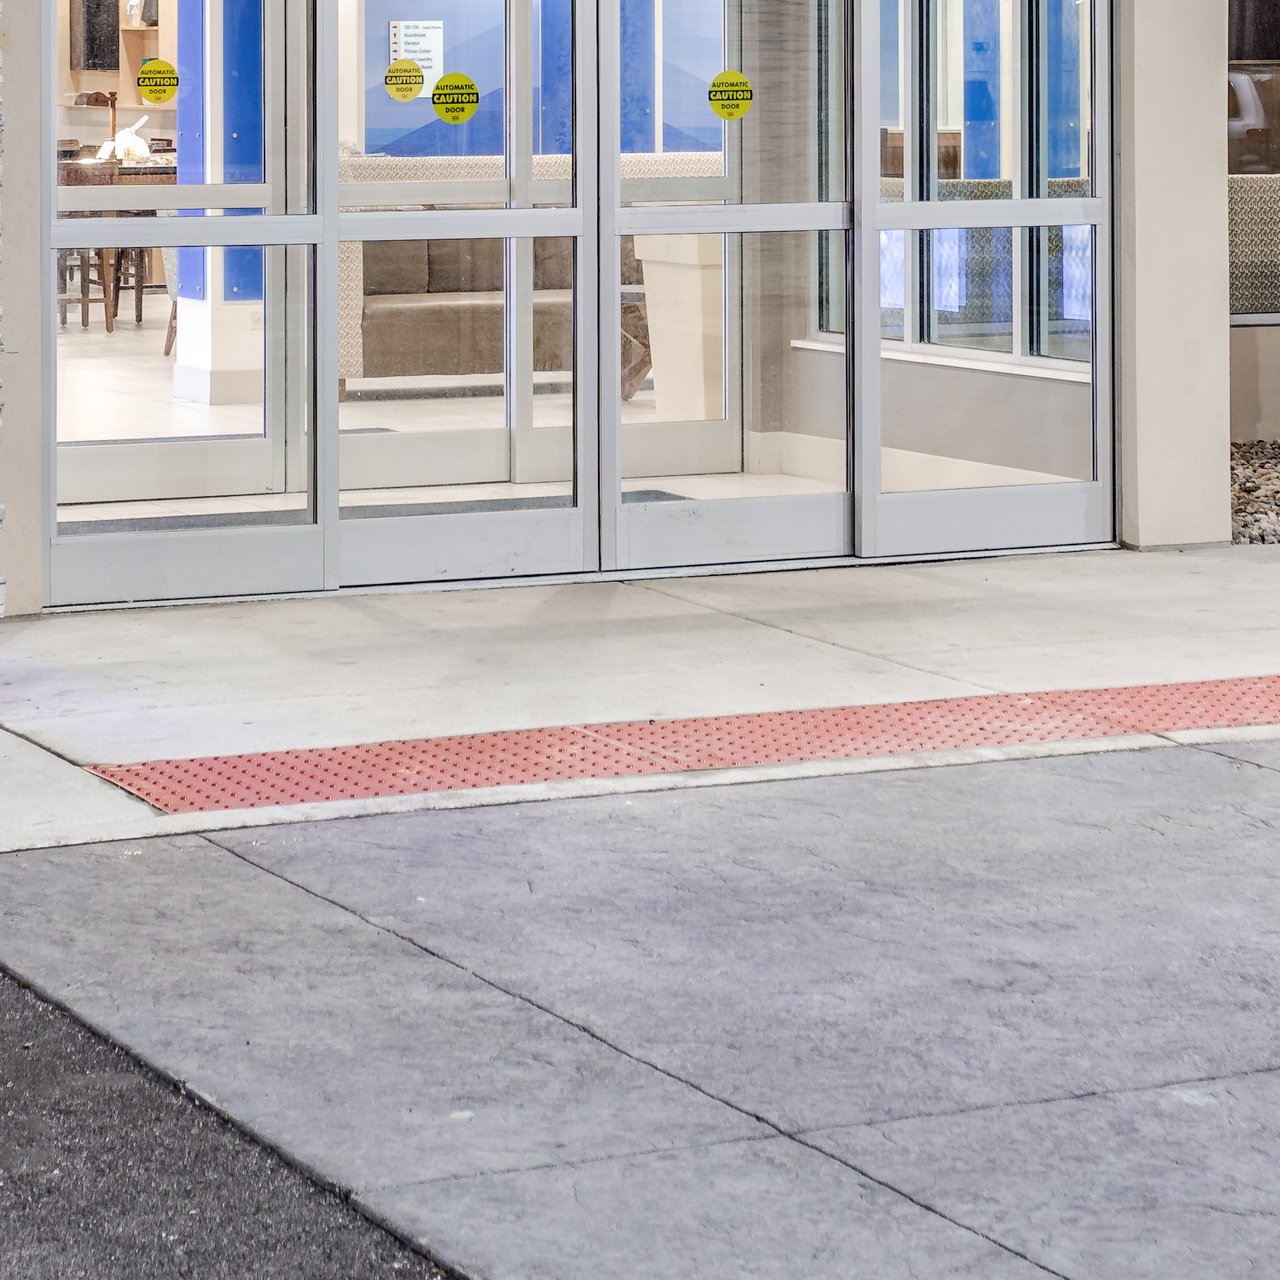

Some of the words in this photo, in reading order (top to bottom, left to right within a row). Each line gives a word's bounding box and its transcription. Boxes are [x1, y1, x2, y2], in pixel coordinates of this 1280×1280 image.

[138, 78, 177, 86] CAUTION
[386, 76, 422, 84] CAUTION
[433, 94, 477, 103] CAUTION
[710, 91, 751, 100] CAUTION
